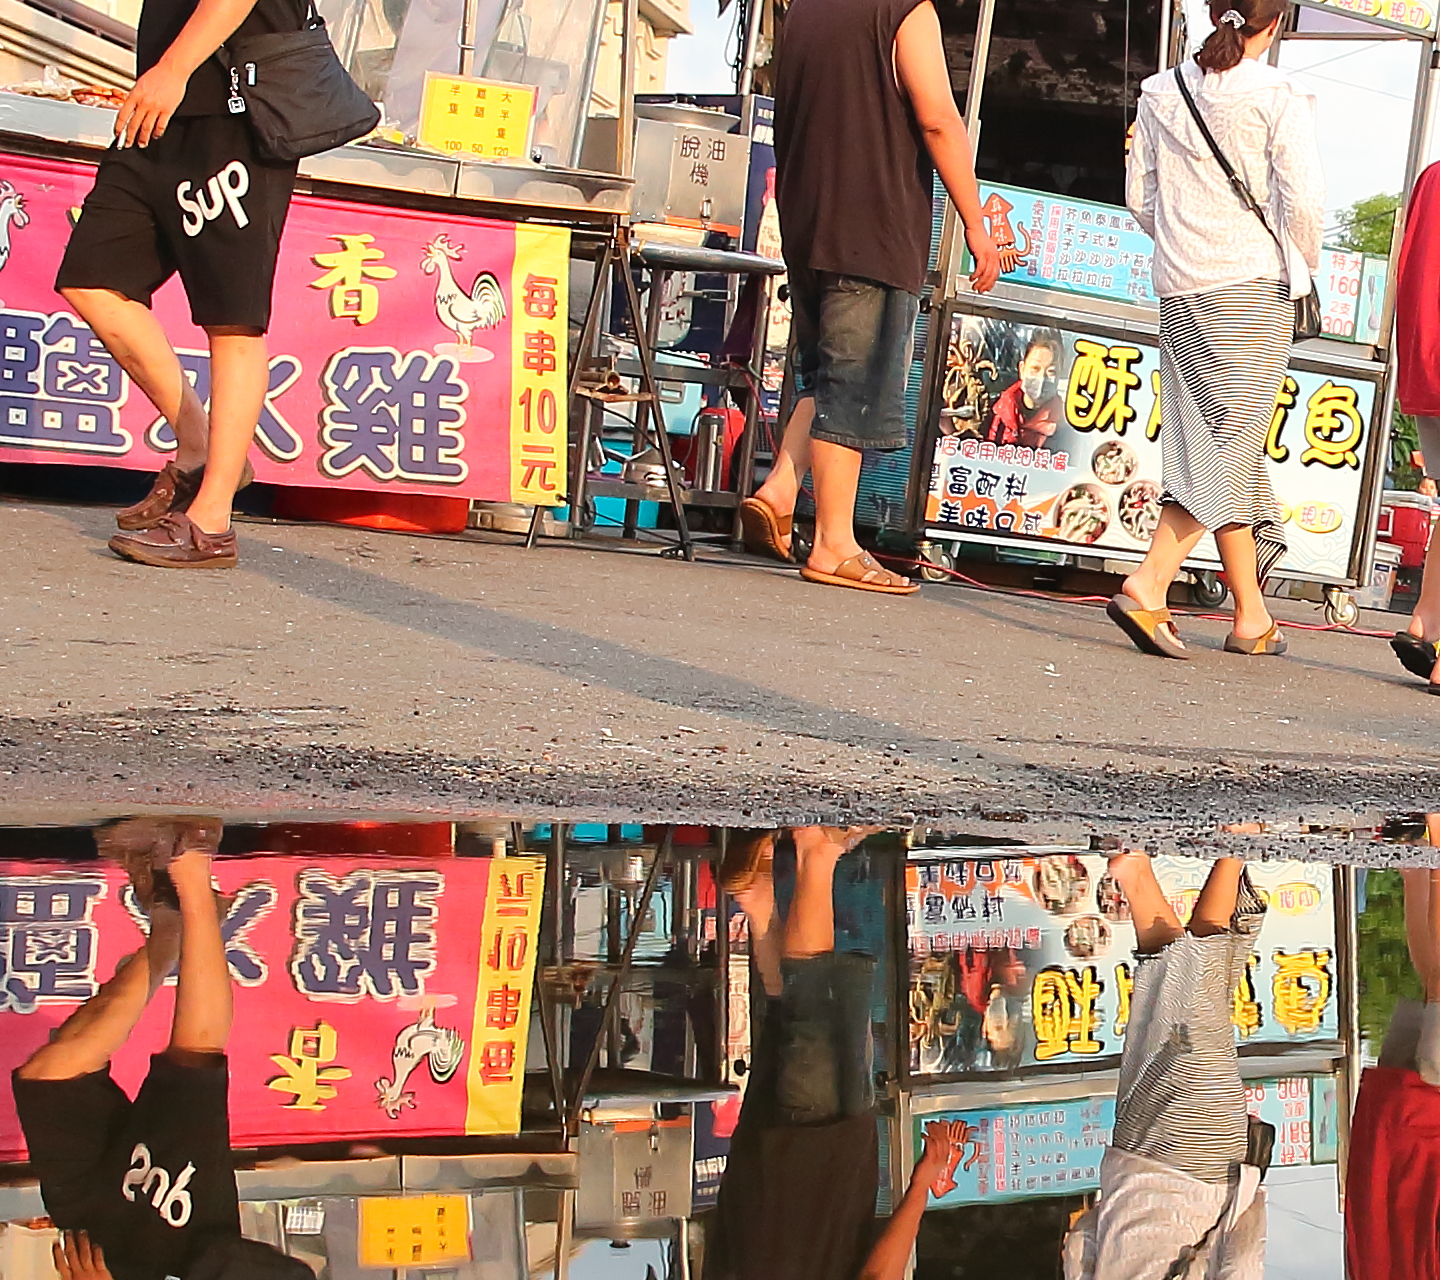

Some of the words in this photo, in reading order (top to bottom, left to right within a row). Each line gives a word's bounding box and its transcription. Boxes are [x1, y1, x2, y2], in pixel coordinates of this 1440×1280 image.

[680, 134, 726, 162] 脫油
[174, 159, 251, 238] Sup
[1328, 274, 1359, 297] 160
[1321, 316, 1354, 338] 300
[519, 273, 559, 492] 每串10元
[1066, 338, 1364, 470] 酥魚
[935, 437, 1069, 471] 店使用脫油設備
